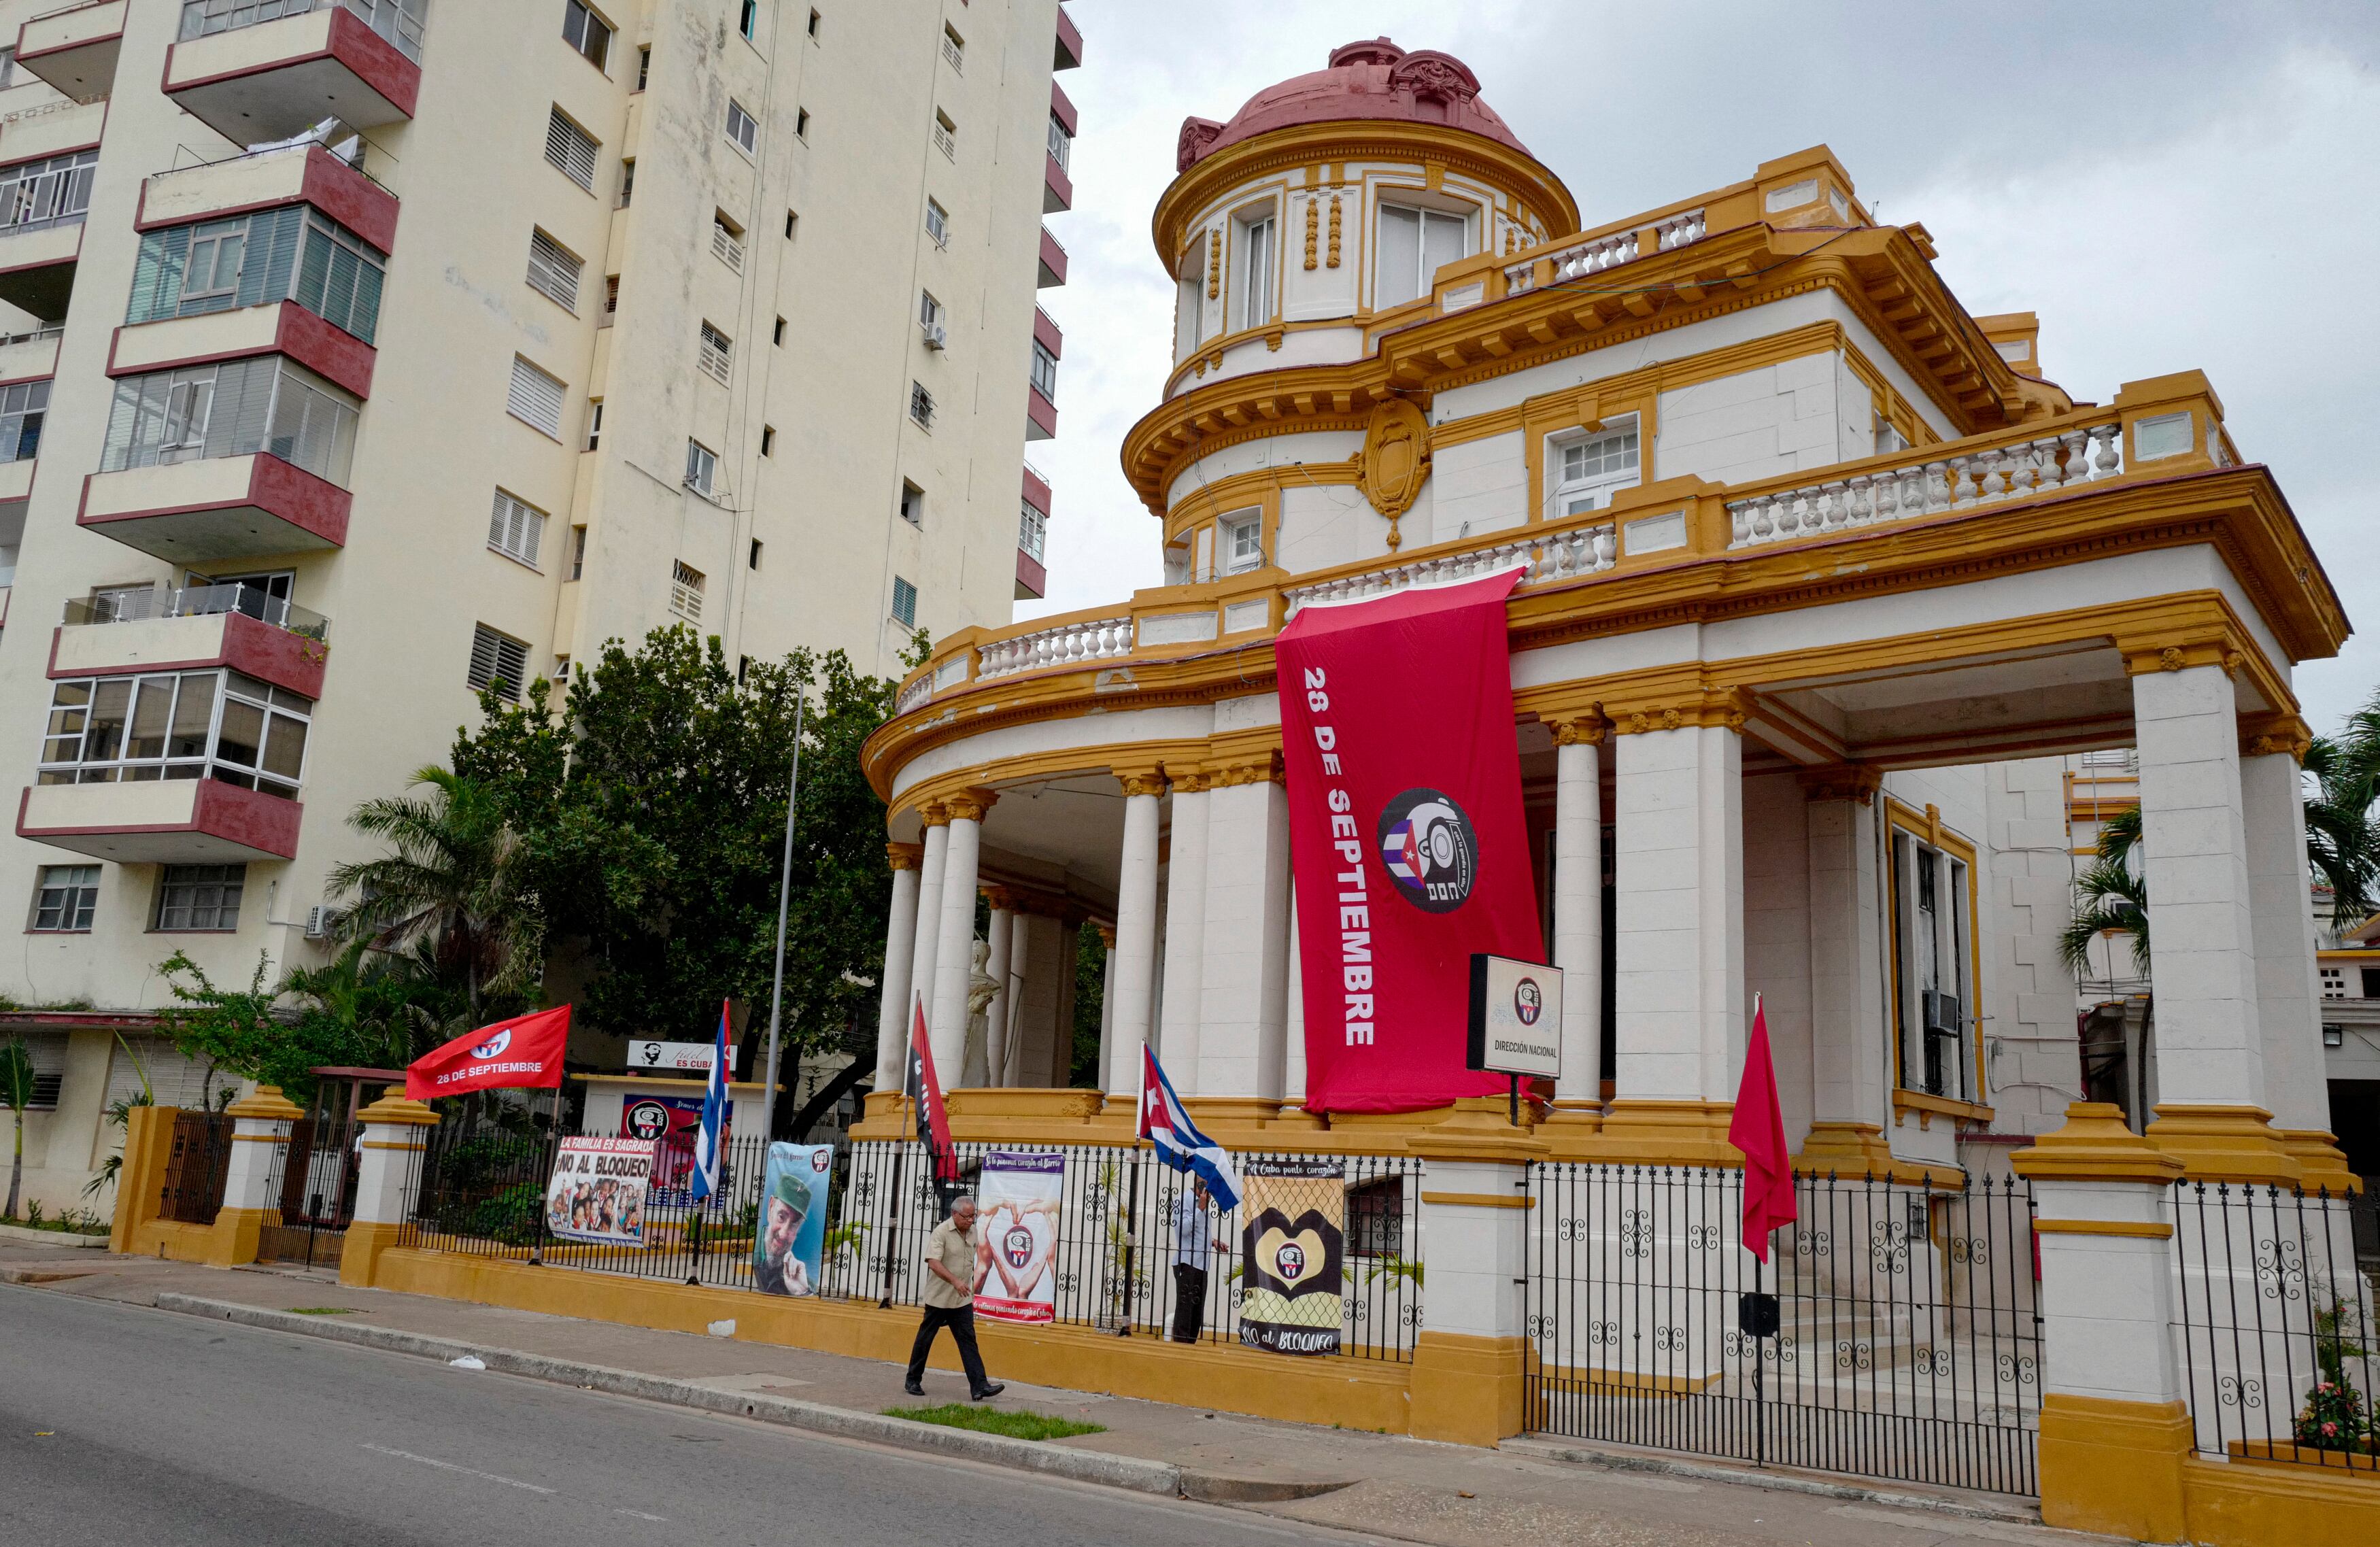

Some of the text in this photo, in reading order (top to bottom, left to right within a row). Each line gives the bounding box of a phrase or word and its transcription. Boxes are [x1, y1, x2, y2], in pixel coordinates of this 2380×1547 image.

[1304, 666, 1374, 1046] 28 DE SEPTIEMBRE
[1459, 848, 1467, 868] guardia
[1495, 1040, 1557, 1058] DIRECCIÓN NACIONAL
[676, 1059, 687, 1068] ES
[437, 1062, 543, 1085] 28 DE SEPTIEMBRE
[560, 1137, 655, 1153] LA FAMILIA ES SAGRADA
[554, 1154, 651, 1178] ¡NO AL BLOQUEO!
[996, 1158, 1017, 1168] ponemos
[1017, 1158, 1037, 1168] corazón
[1037, 1158, 1043, 1166] al
[1043, 1157, 1061, 1169] Barrio
[1250, 1163, 1337, 1176] A Cuba ponle corazón
[978, 1302, 996, 1312] estamos
[996, 1305, 1017, 1314] poniendo
[1242, 1326, 1333, 1352] NO al BLOQUEO
